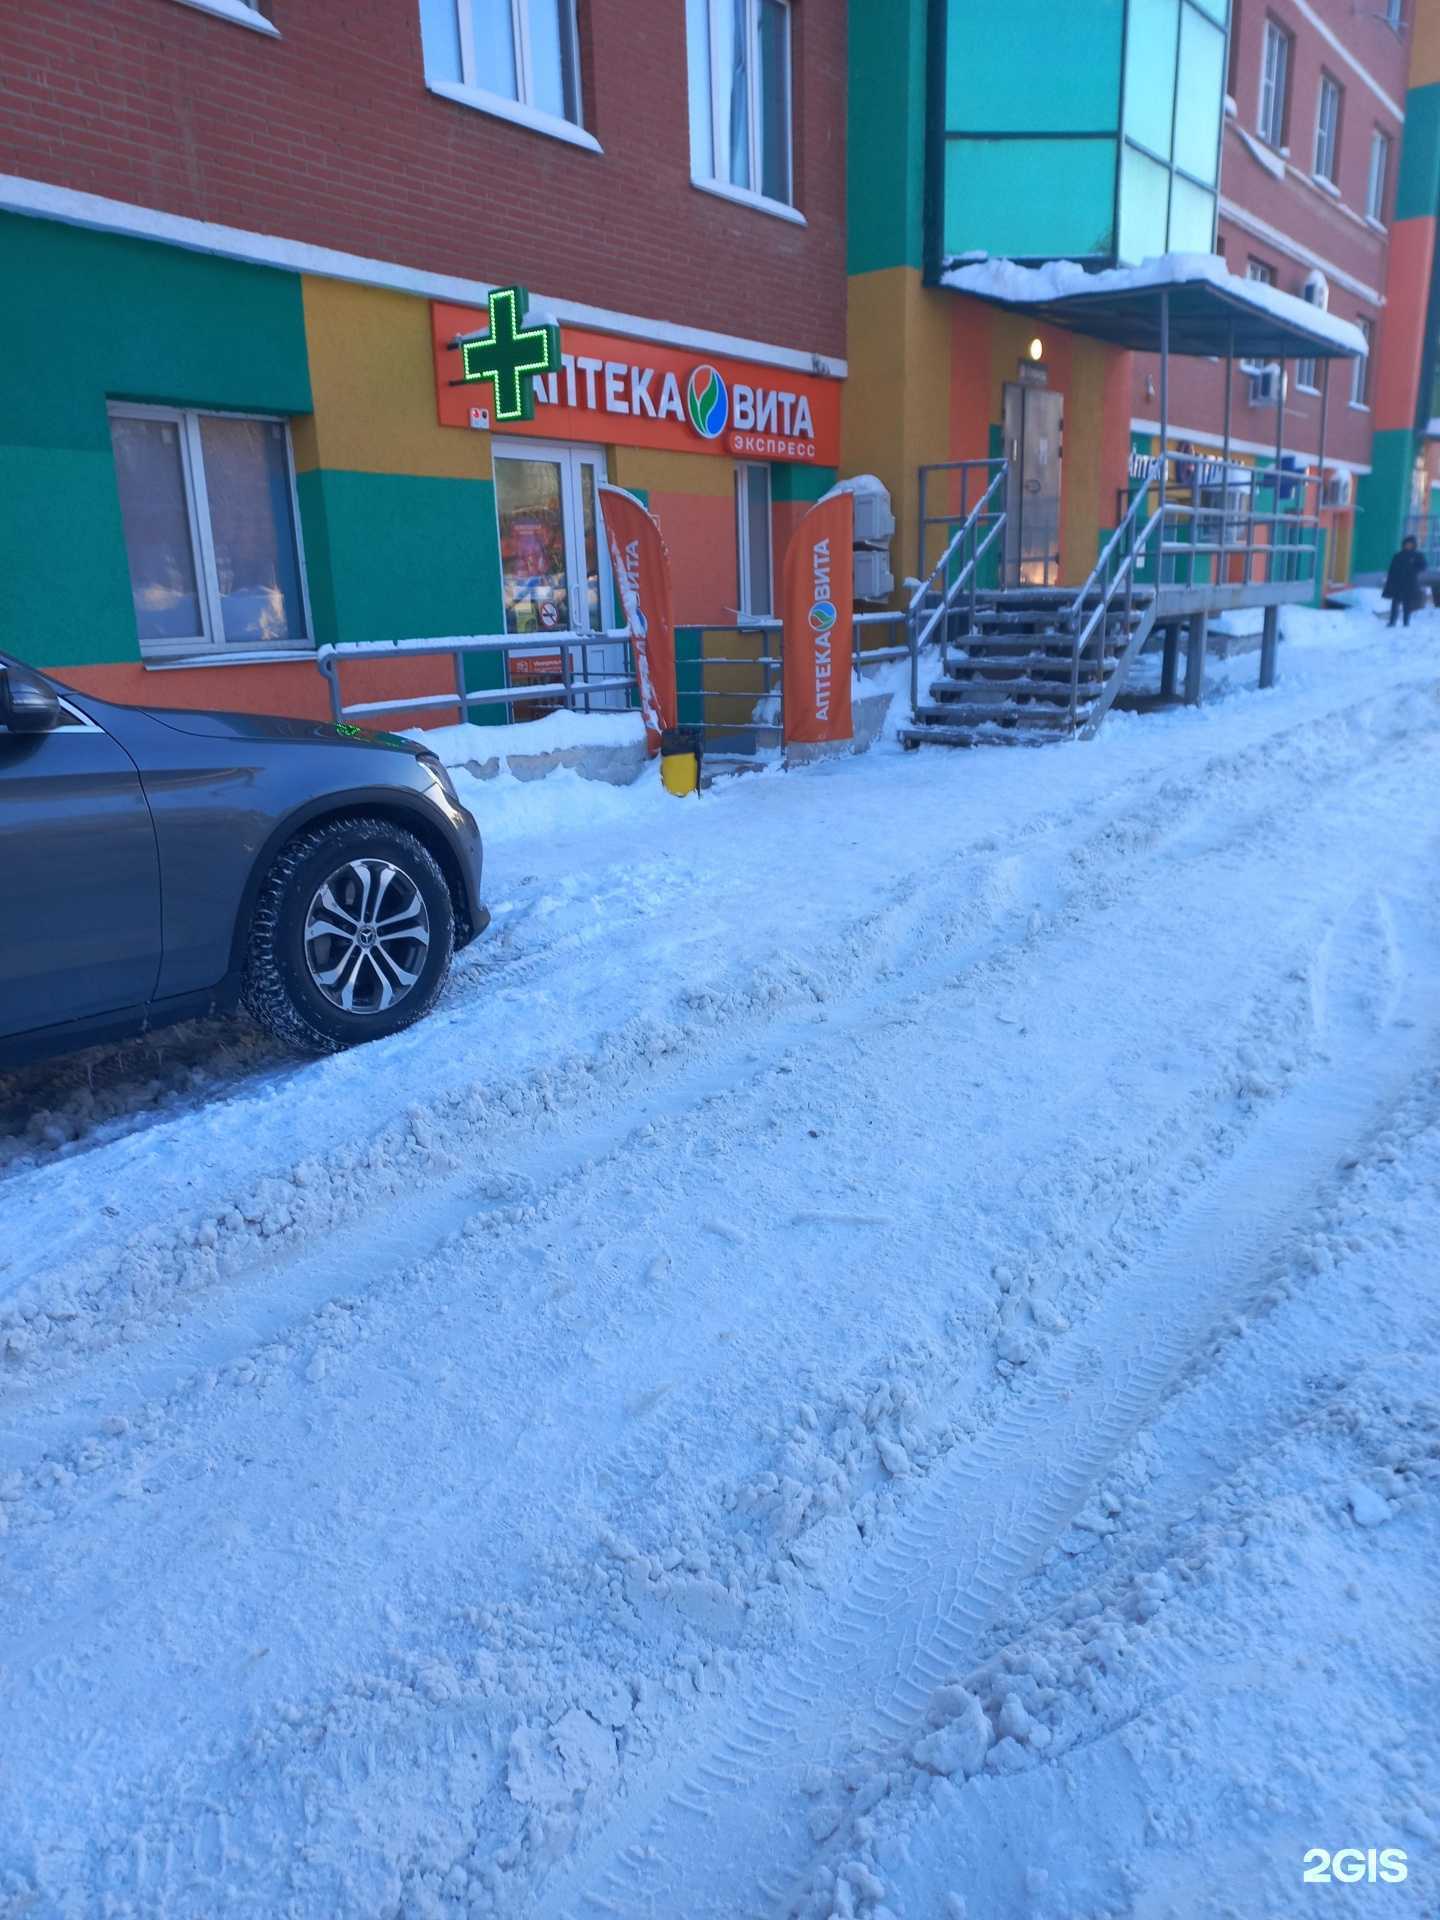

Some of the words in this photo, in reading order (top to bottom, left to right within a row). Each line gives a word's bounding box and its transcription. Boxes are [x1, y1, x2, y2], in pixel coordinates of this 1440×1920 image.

[733, 383, 815, 439] ВИТА
[734, 435, 816, 457] ЭКСПРЕСС
[813, 538, 831, 600] ВИТА
[815, 631, 832, 721] АПТЕКА
